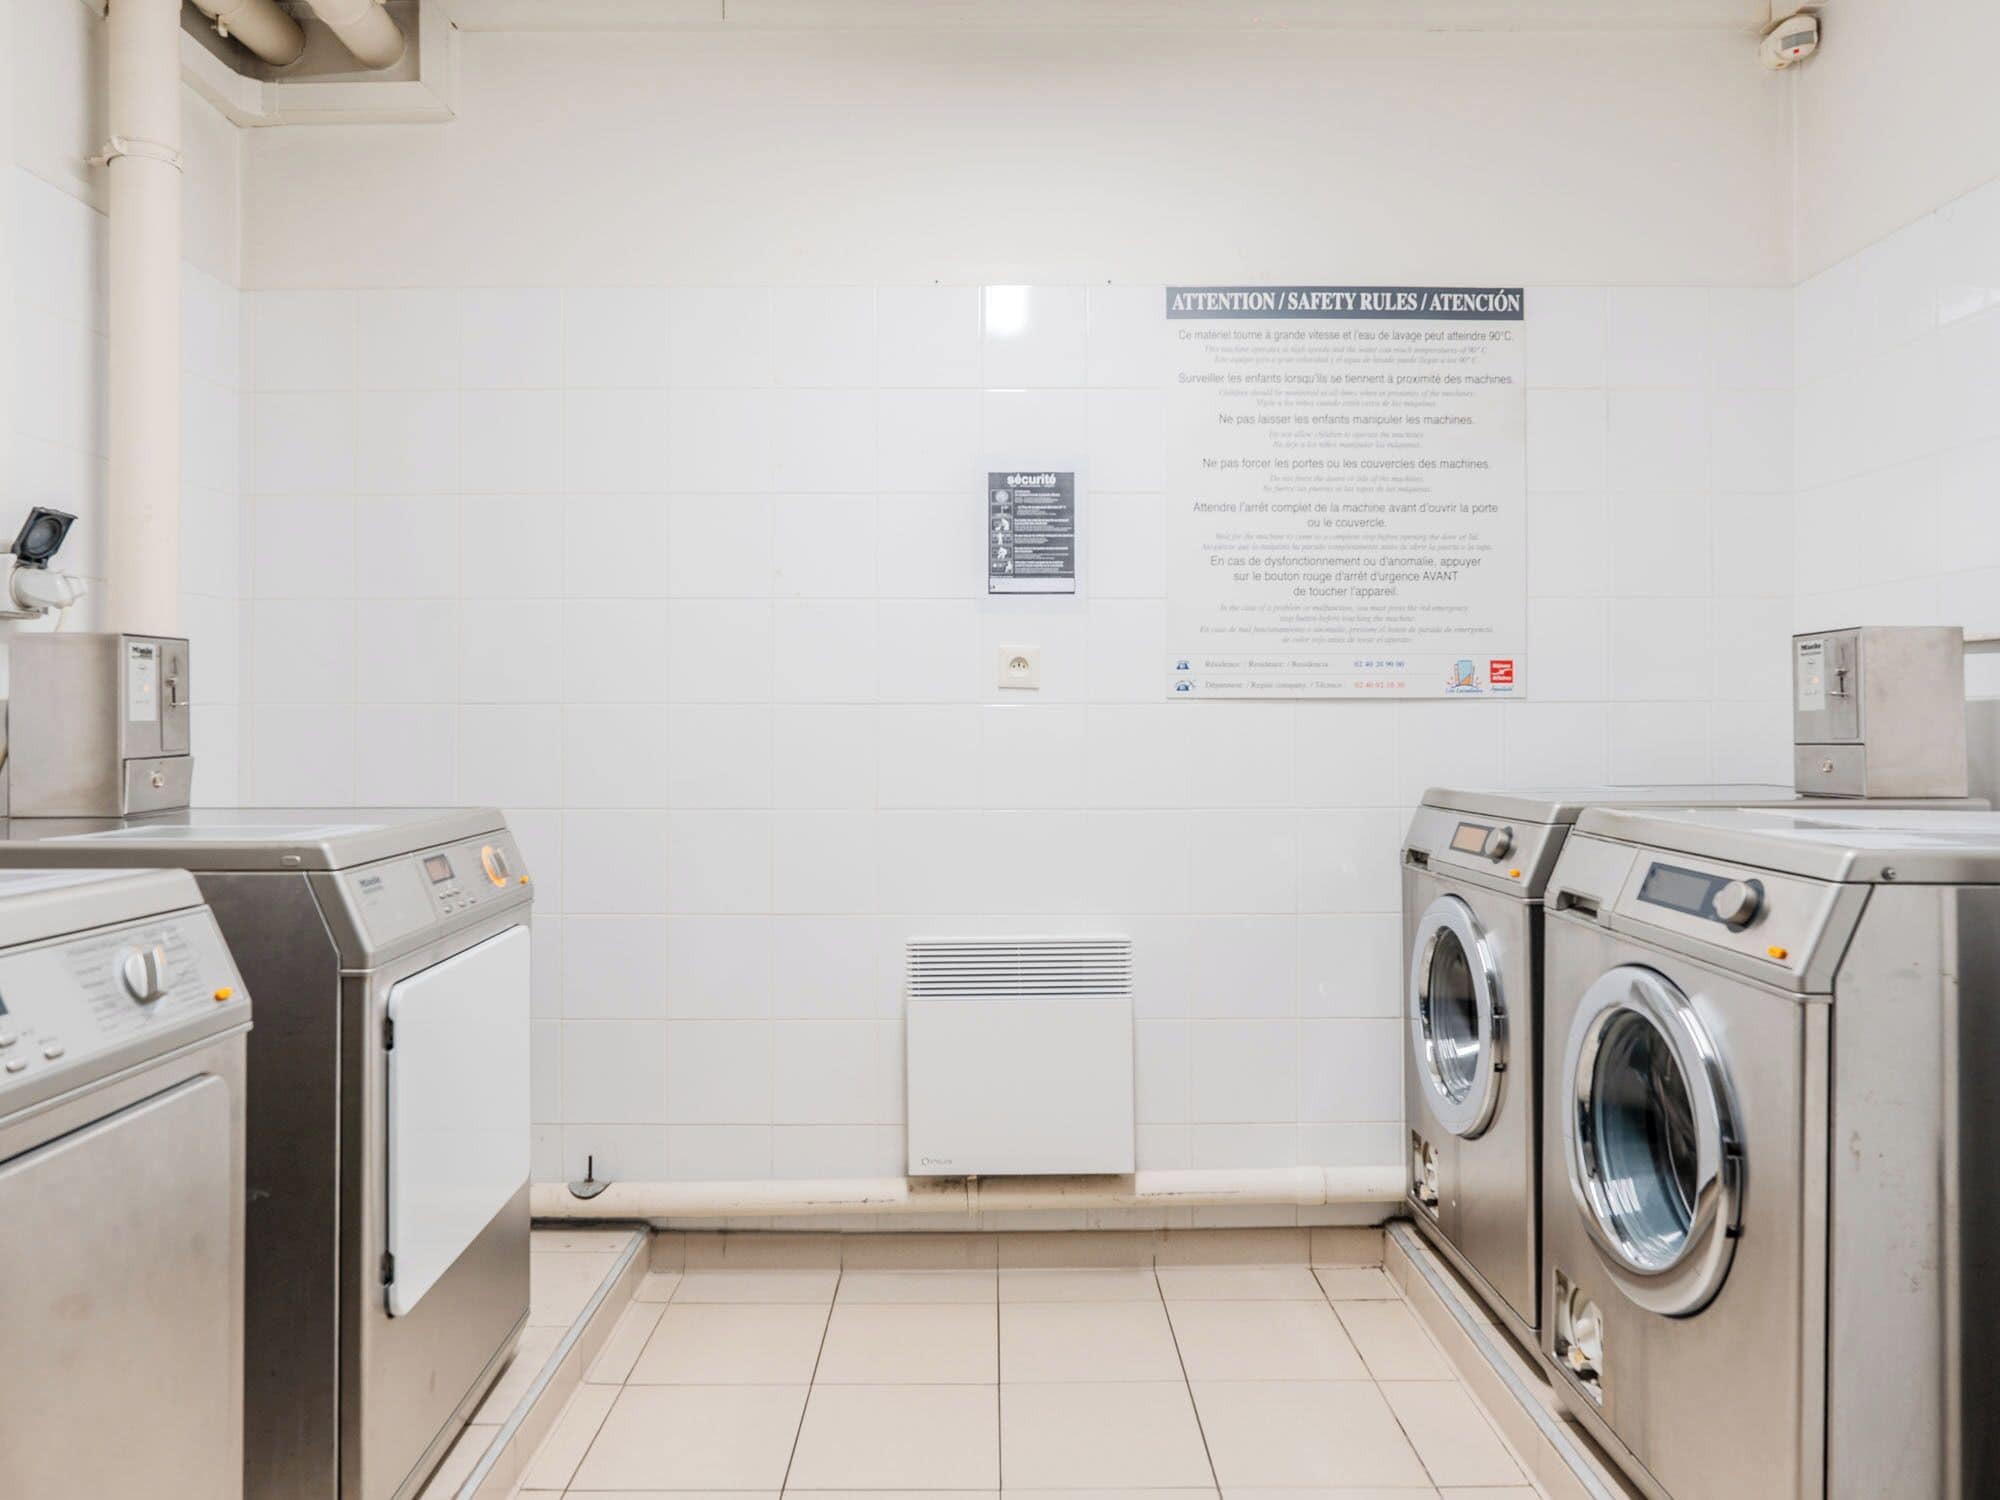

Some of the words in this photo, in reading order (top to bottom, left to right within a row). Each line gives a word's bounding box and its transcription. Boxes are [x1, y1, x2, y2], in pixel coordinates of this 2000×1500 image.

[1172, 292, 1275, 310] ATTENTION
[1288, 292, 1356, 310] SAFETY
[1361, 292, 1417, 310] RULES
[1430, 290, 1520, 312] ATENCIÓN
[1178, 329, 1192, 339] Ce
[1233, 329, 1263, 340] tourne
[1274, 329, 1306, 342] grande
[1309, 329, 1340, 340] vitesse
[1342, 329, 1352, 340] et
[1378, 330, 1389, 340] de
[1392, 330, 1422, 342] lavage
[1424, 330, 1445, 343] peut
[1447, 330, 1486, 340] atteindre
[1178, 372, 1225, 383] Surveiller
[1227, 372, 1242, 383] les
[1245, 372, 1282, 383] enfants
[1284, 373, 1327, 385] lorsqu'ils
[1330, 375, 1342, 383] se
[1345, 373, 1385, 383] tiennent
[1396, 373, 1441, 386] proximité
[1444, 373, 1462, 383] des
[1218, 413, 1234, 424] Ne
[1236, 416, 1256, 426] pas
[1258, 413, 1291, 424] laisser
[1294, 413, 1309, 424] les
[1312, 413, 1350, 424] enfants
[1352, 414, 1402, 426] manipuler
[1405, 414, 1421, 424] les
[1202, 457, 1217, 468] Ne
[1220, 460, 1239, 470] pas
[1242, 457, 1271, 468] forcer
[1274, 457, 1289, 468] les
[1292, 458, 1324, 470] portes
[1327, 460, 1340, 468] ou
[1343, 458, 1358, 468] les
[1361, 458, 1415, 468] couvercles
[1418, 458, 1437, 468] des
[1007, 473, 1056, 485] sécurité
[1193, 501, 1237, 512] Attendre
[1239, 501, 1269, 512] l'arrêt
[1271, 502, 1312, 514] complet
[1314, 502, 1327, 512] de
[1330, 502, 1340, 512] la
[1342, 502, 1386, 512] machine
[1389, 502, 1417, 512] avant
[1419, 502, 1457, 512] d'ouvrir
[1460, 502, 1469, 512] la
[1471, 502, 1499, 515] porte
[1306, 519, 1321, 527] ou
[1323, 517, 1333, 527] le
[1210, 555, 1225, 565] En
[1227, 557, 1245, 565] cas
[1248, 555, 1261, 565] de
[1264, 555, 1361, 568] dysfonctionnement
[1363, 558, 1376, 566] ou
[1440, 558, 1482, 568] appuyer
[1233, 573, 1249, 581] sur
[1252, 570, 1262, 581] le
[1264, 570, 1300, 581] bouton
[1303, 573, 1332, 583] rouge
[1335, 570, 1368, 581] d'arrêt
[1370, 571, 1420, 583] d'urgence
[1422, 571, 1458, 581] AVANT
[1293, 585, 1306, 596] de
[1309, 585, 1347, 596] toucher
